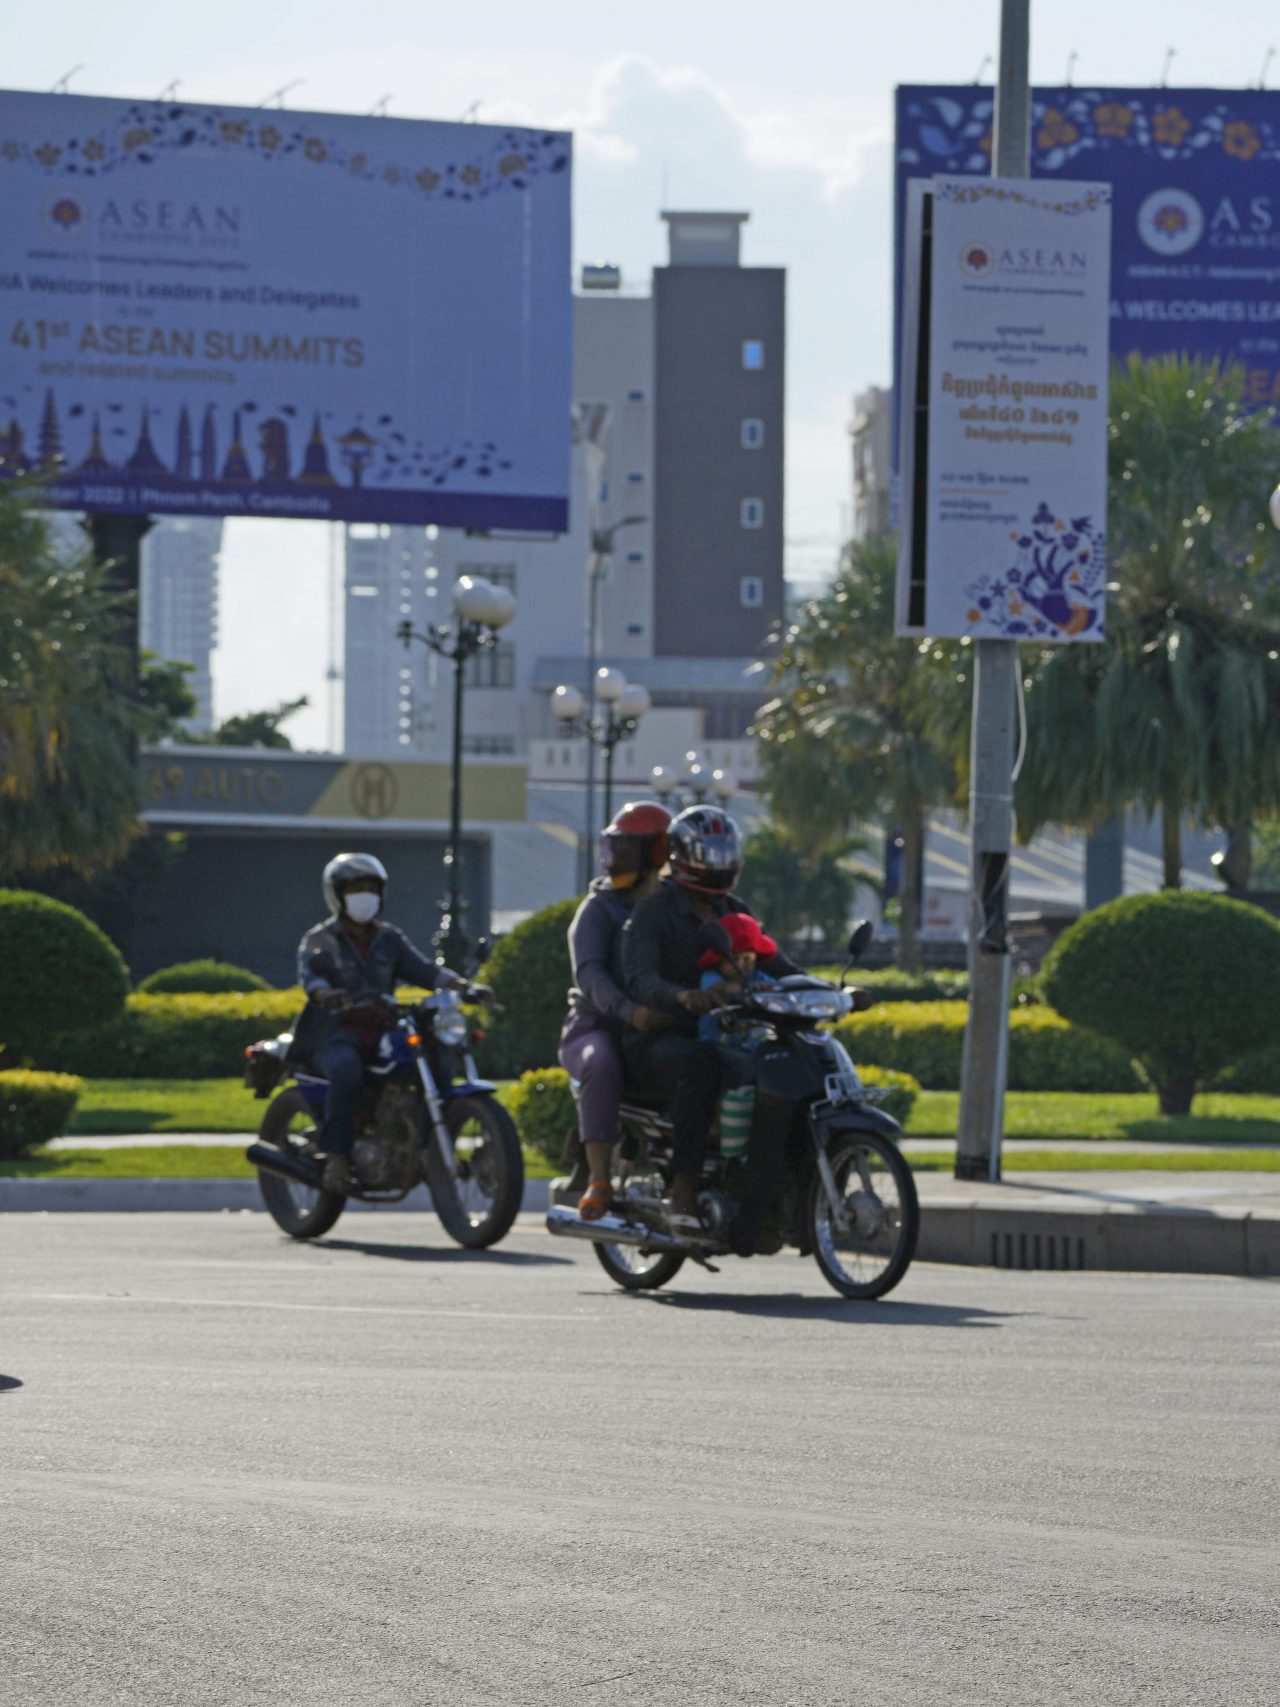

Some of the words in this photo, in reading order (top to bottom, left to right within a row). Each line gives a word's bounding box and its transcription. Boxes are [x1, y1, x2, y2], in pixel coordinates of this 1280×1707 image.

[101, 199, 240, 232] ASEAN
[1000, 248, 1086, 268] ASEAN
[28, 274, 131, 296] Welcomes
[136, 279, 212, 302] Leaders
[218, 285, 256, 305] and
[259, 285, 360, 313] Delegates
[1125, 301, 1245, 322] WELCOMES
[78, 322, 194, 359] ASEAN
[202, 329, 365, 368] SUMMITS
[193, 767, 284, 804] AUTO
